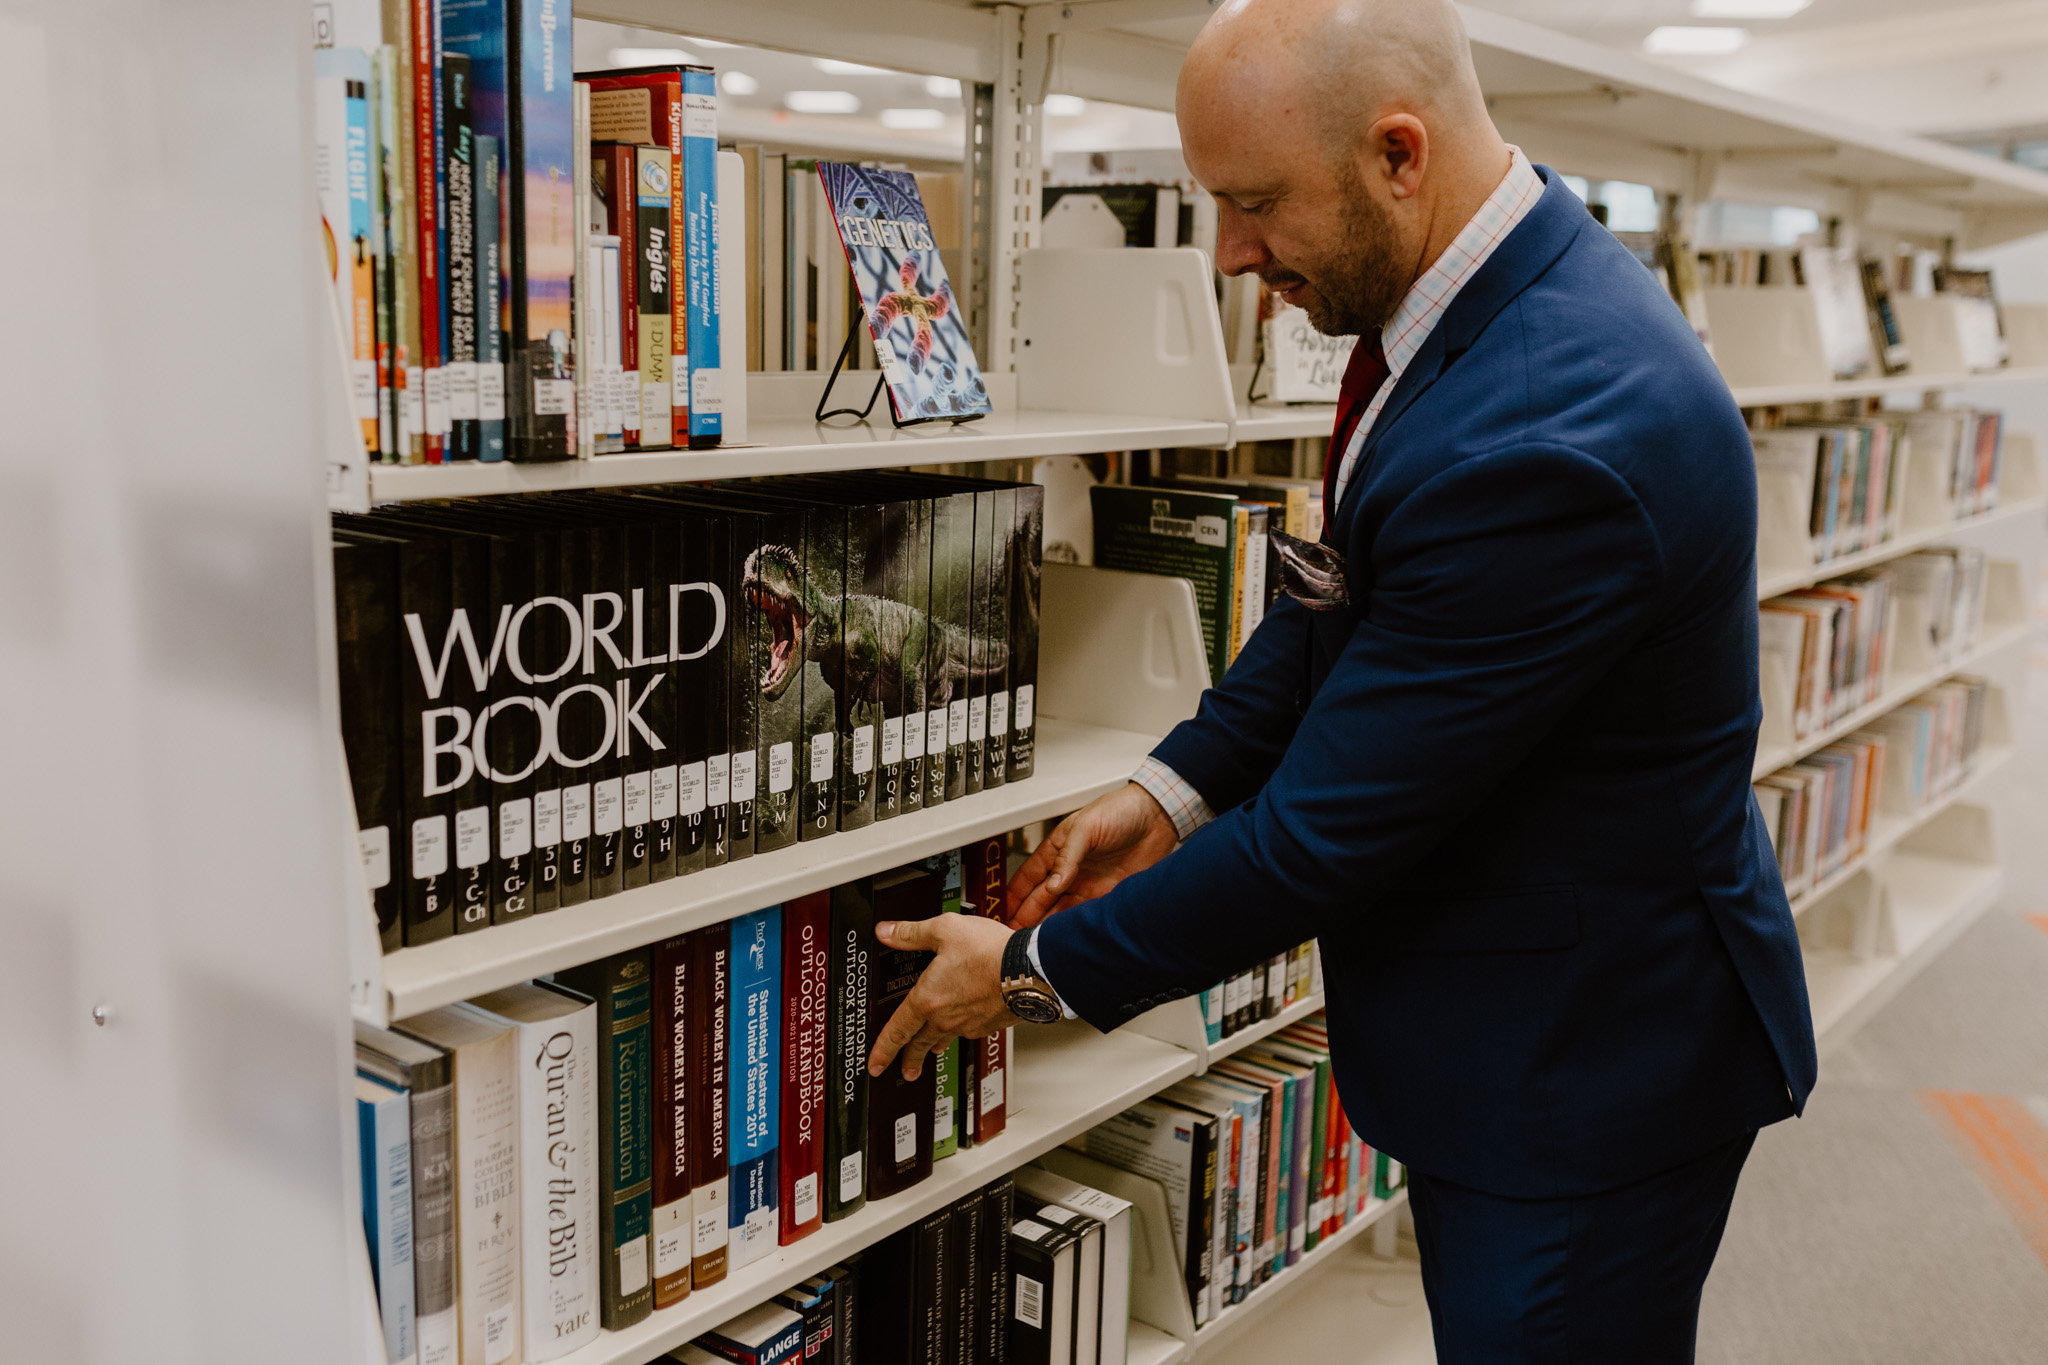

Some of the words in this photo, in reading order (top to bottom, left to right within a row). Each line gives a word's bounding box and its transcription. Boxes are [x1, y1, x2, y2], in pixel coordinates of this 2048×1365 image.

[668, 102, 682, 155] Kiyama
[454, 125, 471, 163] Easy
[347, 126, 368, 203] FLIGHT
[673, 162, 683, 188] The
[673, 191, 684, 222] Four
[709, 201, 719, 246] Jackie
[843, 215, 934, 251] GENETICS
[646, 227, 666, 294] Inglés
[673, 225, 686, 302] Immigrants
[462, 257, 473, 314] SOURCES
[691, 275, 700, 306] Moore
[712, 250, 721, 315] Robinson
[452, 281, 463, 313] NEW
[463, 316, 474, 342] FOR
[674, 305, 687, 350] Manga
[1201, 525, 1219, 536] CEN
[403, 581, 727, 699] WORLD
[421, 673, 667, 797] BOOK
[993, 735, 1003, 747] 21
[1018, 728, 1028, 740] 22
[954, 744, 964, 757] 19
[972, 740, 982, 752] 20
[910, 759, 921, 771] 17
[934, 753, 944, 765] 18
[974, 755, 980, 767] U
[990, 750, 1006, 763] WX
[887, 765, 897, 777] 16
[955, 760, 961, 772] T
[992, 765, 1004, 778] YZ
[857, 774, 866, 786] 15
[911, 775, 920, 788] S-
[931, 769, 944, 782] So-
[974, 771, 980, 782] V
[817, 781, 827, 794] 14
[859, 789, 865, 802] P
[886, 780, 896, 795] Q
[933, 785, 943, 798] Sz
[775, 792, 786, 806] 13
[818, 798, 826, 812] N
[888, 797, 894, 810] R
[909, 792, 920, 804] Sn
[713, 805, 725, 819] 11
[739, 801, 751, 815] 12
[687, 812, 701, 827] 10
[775, 810, 786, 824] M
[817, 816, 827, 829] O
[634, 825, 643, 839] 8
[661, 820, 669, 833] 9
[742, 819, 748, 833] L
[572, 840, 582, 854] 6
[605, 833, 613, 847] 7
[661, 837, 671, 852] H
[716, 841, 724, 856] K
[546, 846, 555, 861] 5
[606, 851, 613, 866] F
[633, 843, 644, 858] G
[510, 857, 519, 871] 4
[573, 859, 581, 874] E
[469, 865, 479, 881] 3
[544, 865, 556, 881] D
[426, 876, 436, 892] 2
[466, 884, 484, 901] C-
[504, 875, 525, 893] Ci-
[426, 895, 438, 912] B
[505, 896, 525, 913] Cz
[464, 903, 486, 922] Ch
[705, 924, 726, 936] HINE
[665, 938, 687, 950] HINE
[754, 921, 766, 971] ProQuest
[714, 949, 725, 1002] BLACK
[801, 925, 813, 1025] OUTLOOK
[846, 930, 857, 1008] OUTLOOK
[900, 961, 915, 975] LAW
[887, 971, 922, 992] DICTIONA
[674, 963, 685, 1018] BLACK
[748, 993, 758, 1017] the
[856, 950, 868, 1076] OCCUPATIONAL
[758, 989, 769, 1060] Statistical
[813, 951, 826, 1108] OCCUPATIONAL
[713, 1004, 725, 1063] WOMEN
[747, 1019, 758, 1065] United
[674, 1019, 685, 1080] WOMEN
[844, 1012, 856, 1104] HANDBOOK
[567, 1054, 576, 1080] The
[789, 1043, 797, 1083] EDITION
[713, 1065, 723, 1084] IN
[674, 1082, 685, 1101] IN
[747, 1067, 757, 1113] States
[758, 1062, 769, 1121] Abstract
[799, 1030, 813, 1145] HANDBOOK
[619, 1039, 637, 1182] Reformation
[713, 1088, 723, 1158] AMERICA
[747, 1115, 757, 1148] 2017
[758, 1123, 768, 1137] of
[674, 1105, 685, 1177] AMERICA
[474, 1145, 513, 1168] HARPER
[474, 1156, 513, 1179] COLLINS
[474, 1168, 514, 1193] STUDY
[474, 1181, 514, 1209] BIBLE
[548, 1177, 576, 1221] the
[710, 1190, 716, 1200] 2
[672, 1209, 677, 1220] 1
[549, 1219, 577, 1277] Bib
[968, 1211, 977, 1286] ENCYCLOPEDIA
[665, 1277, 687, 1291] OXFORD
[618, 1291, 651, 1311] OXFORD
[554, 1311, 591, 1340] Yale
[823, 1330, 828, 1338] 2
[760, 1329, 801, 1365] LANGE
